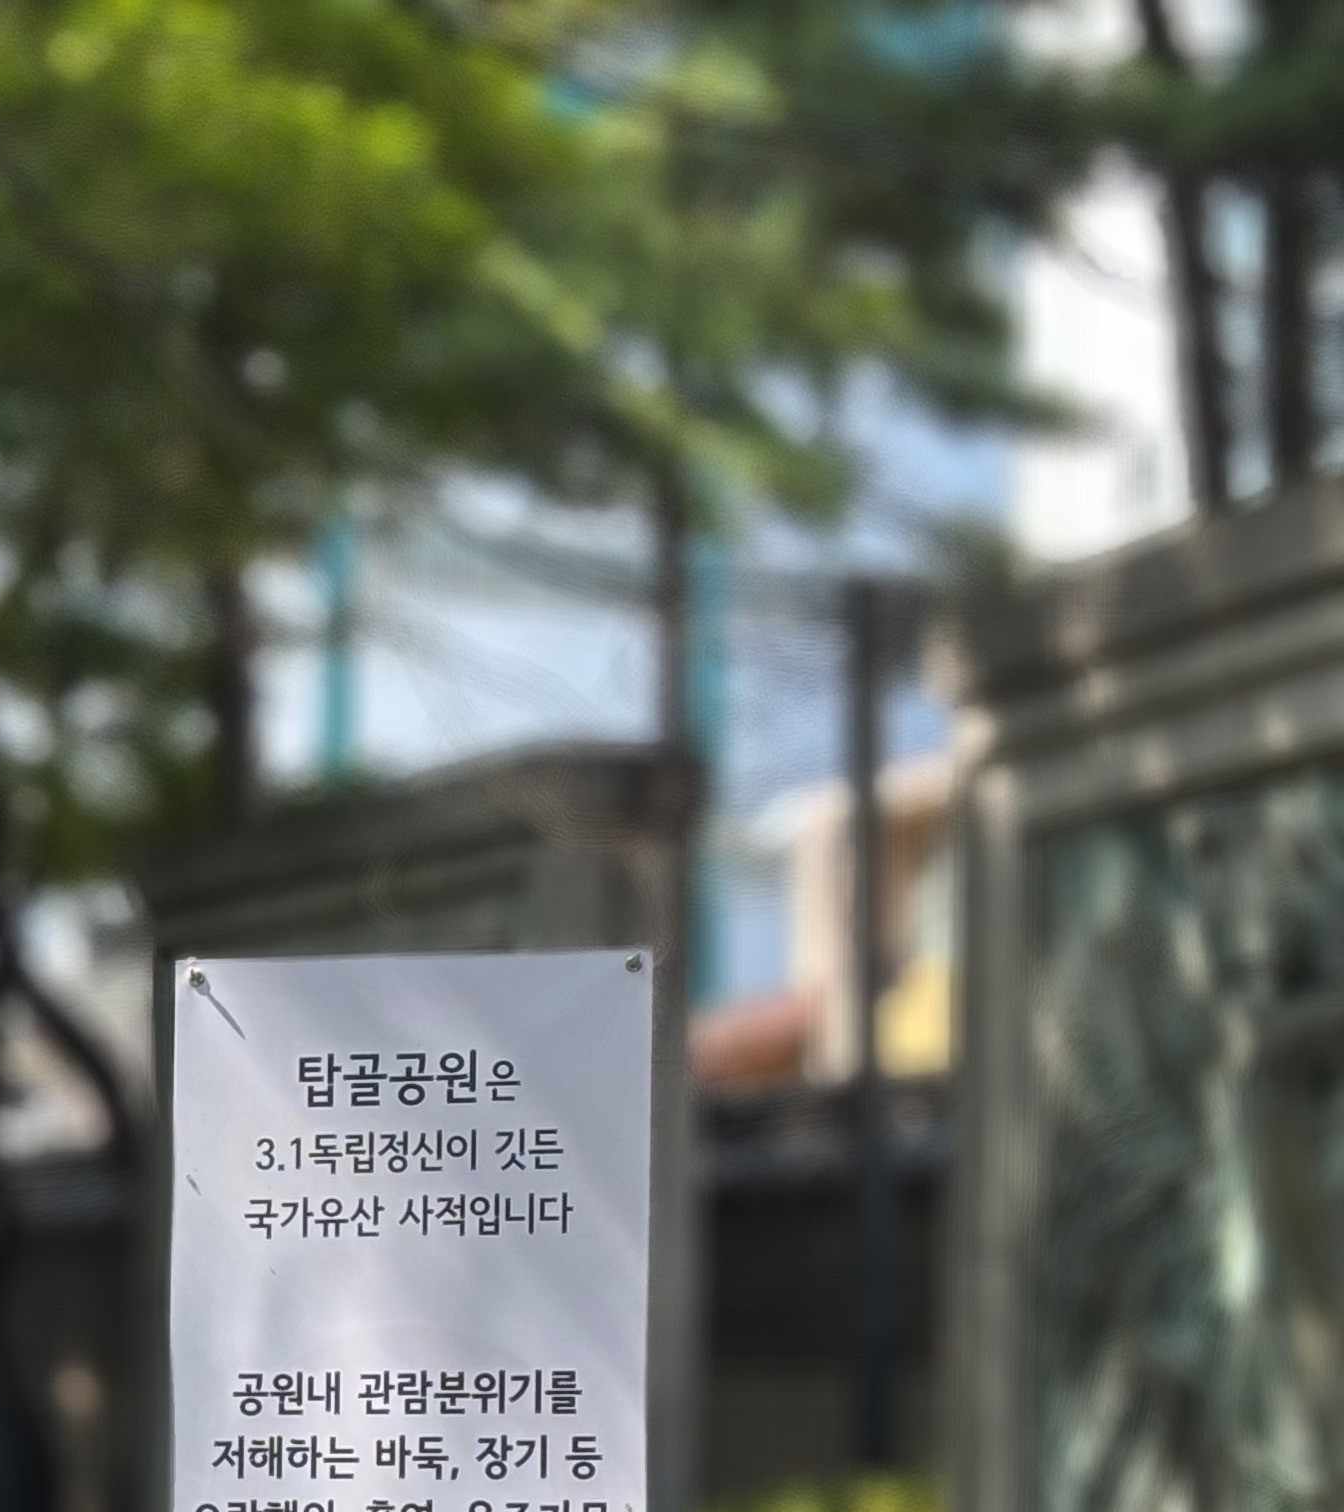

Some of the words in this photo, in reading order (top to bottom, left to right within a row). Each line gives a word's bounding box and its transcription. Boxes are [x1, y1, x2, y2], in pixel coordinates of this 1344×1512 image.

[298, 1049, 521, 1107] 탑골공원은
[256, 1129, 477, 1174] 3.1독립정신이
[495, 1128, 564, 1170] 깃든
[244, 1196, 384, 1239] 국가유산
[399, 1192, 573, 1236] 사적입니다
[232, 1371, 341, 1416] 공원내
[358, 1369, 582, 1415] 관람분위기를
[212, 1436, 359, 1479] 저해하는
[376, 1435, 459, 1480] 바둑,
[476, 1435, 548, 1479] 장기
[565, 1436, 602, 1479] 등
